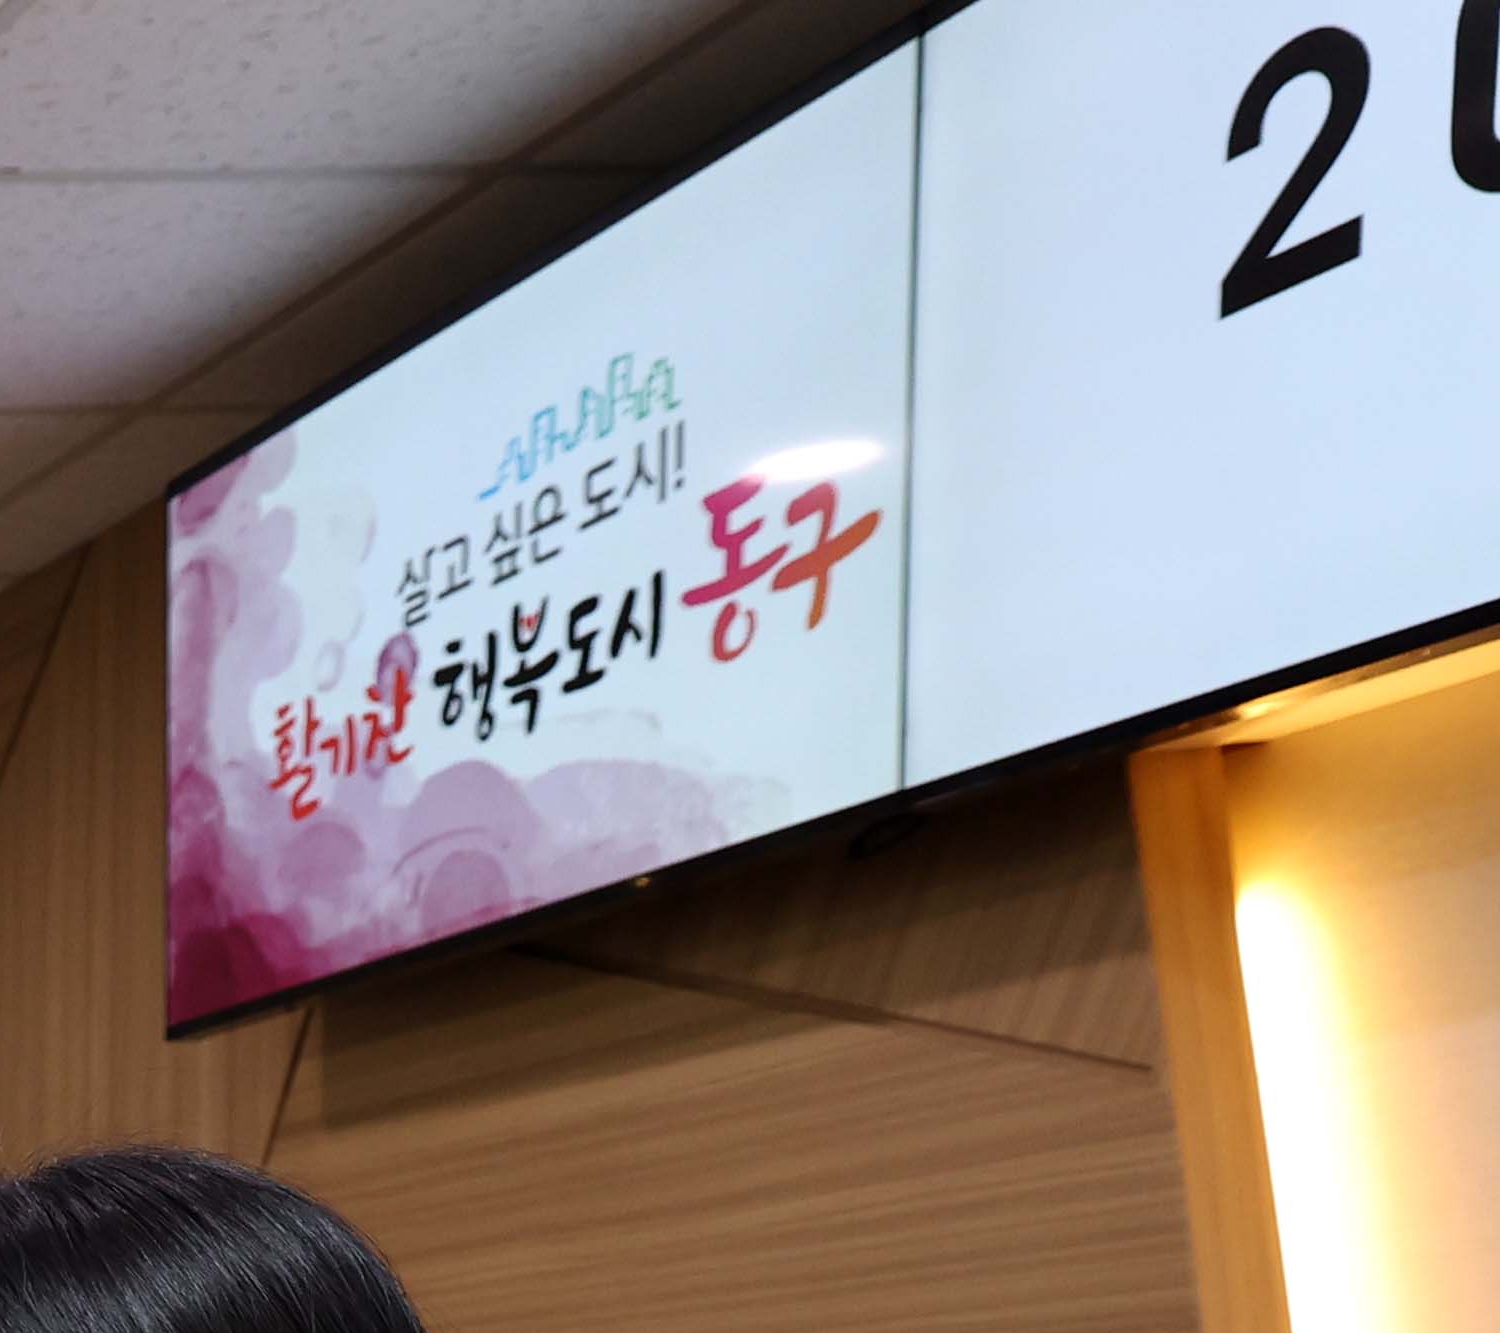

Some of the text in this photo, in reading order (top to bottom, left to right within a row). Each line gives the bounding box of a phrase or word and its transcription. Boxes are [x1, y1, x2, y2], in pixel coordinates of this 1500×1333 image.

[268, 473, 883, 822] 활기찬 행복도시 동구
[397, 421, 687, 629] 살고 싶은 도시!
